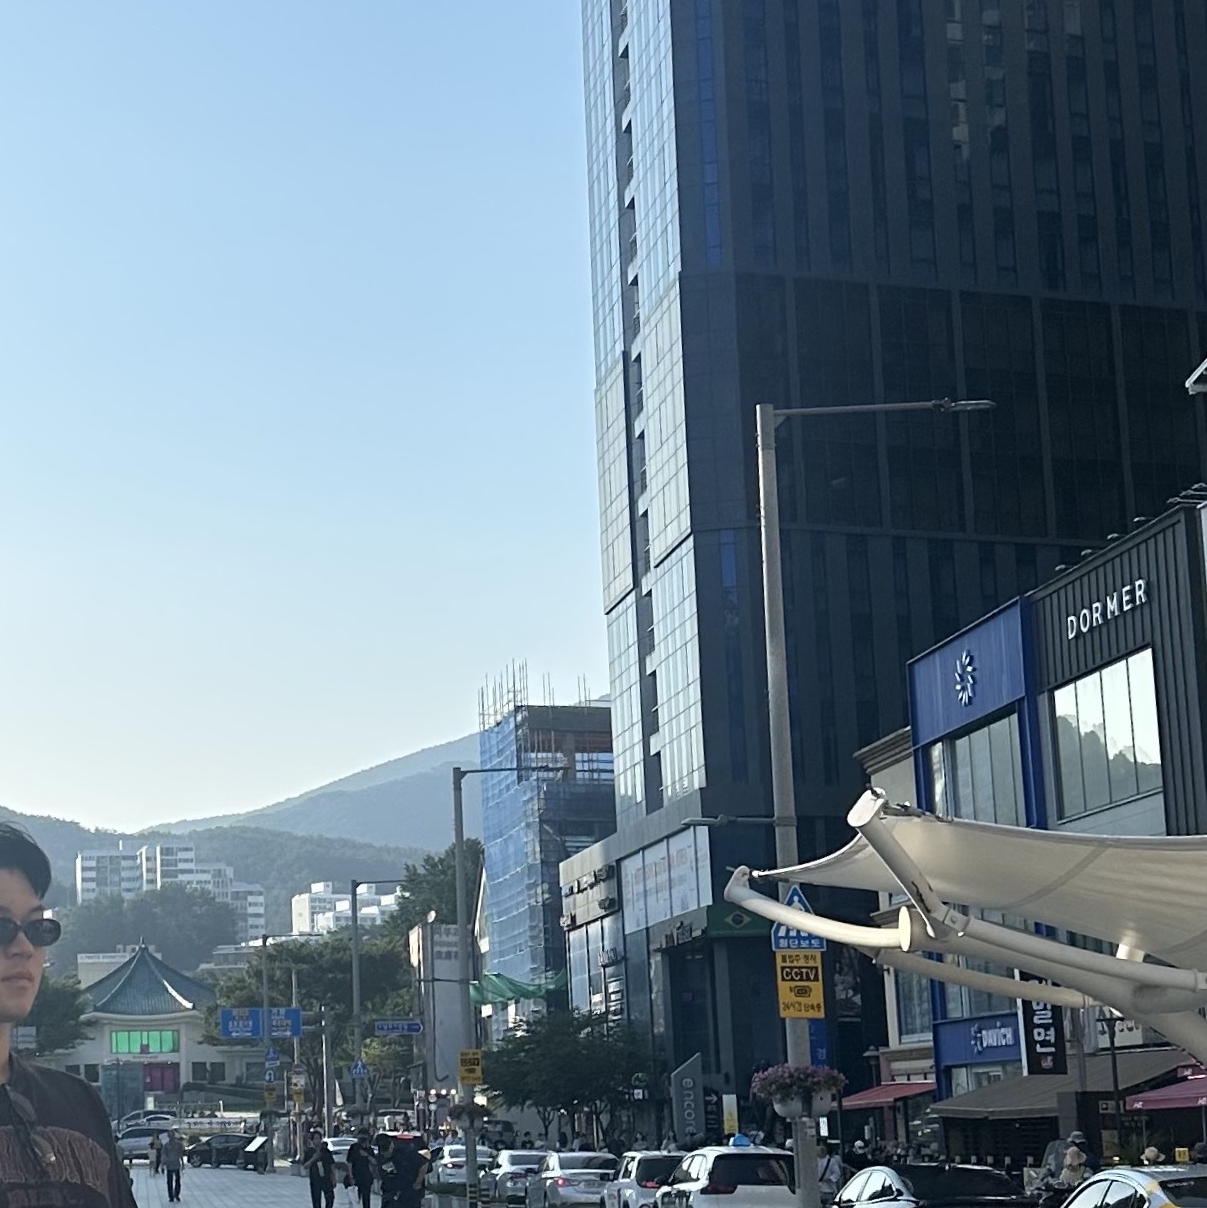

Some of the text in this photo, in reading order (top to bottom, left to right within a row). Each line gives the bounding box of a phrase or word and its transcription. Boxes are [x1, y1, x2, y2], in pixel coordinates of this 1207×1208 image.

[1066, 578, 1148, 640] DORMER
[779, 938, 820, 948] 횡단보도
[782, 968, 817, 981] CCTV
[681, 1077, 697, 1136] encore
